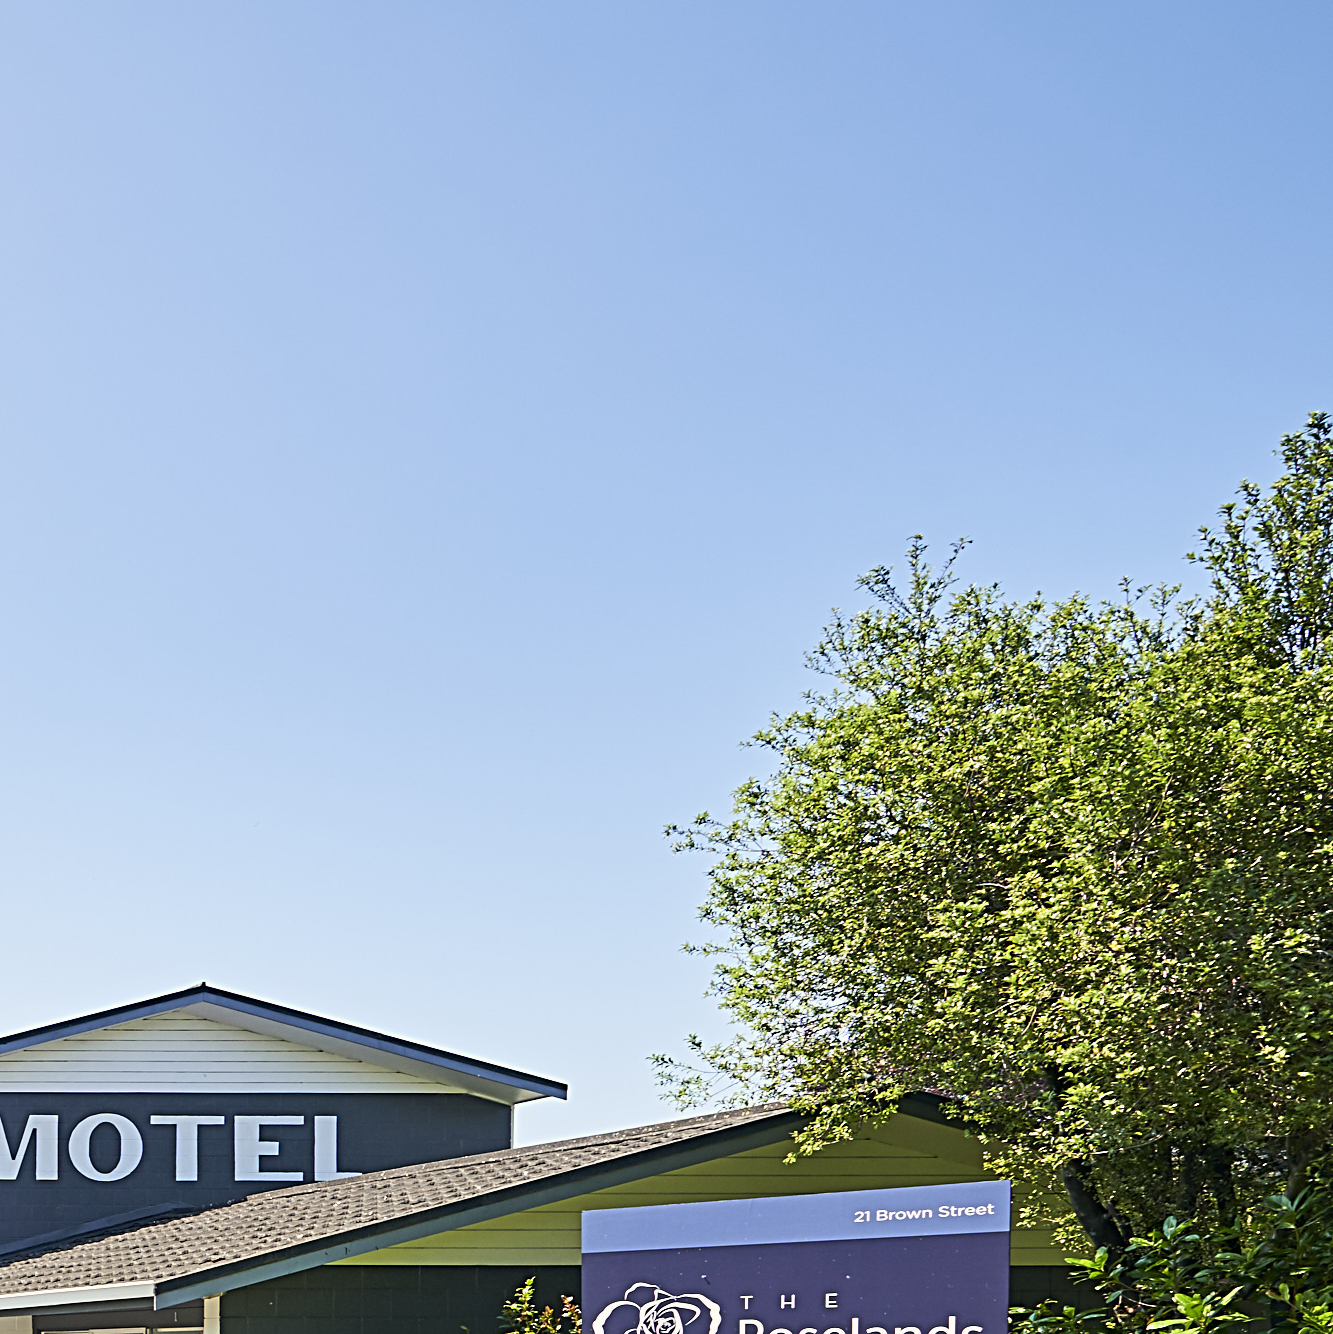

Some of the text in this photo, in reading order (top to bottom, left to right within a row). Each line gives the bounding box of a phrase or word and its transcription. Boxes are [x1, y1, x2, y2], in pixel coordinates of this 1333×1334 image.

[853, 1203, 995, 1223] 21 Brown Street
[740, 1292, 839, 1310] THE
